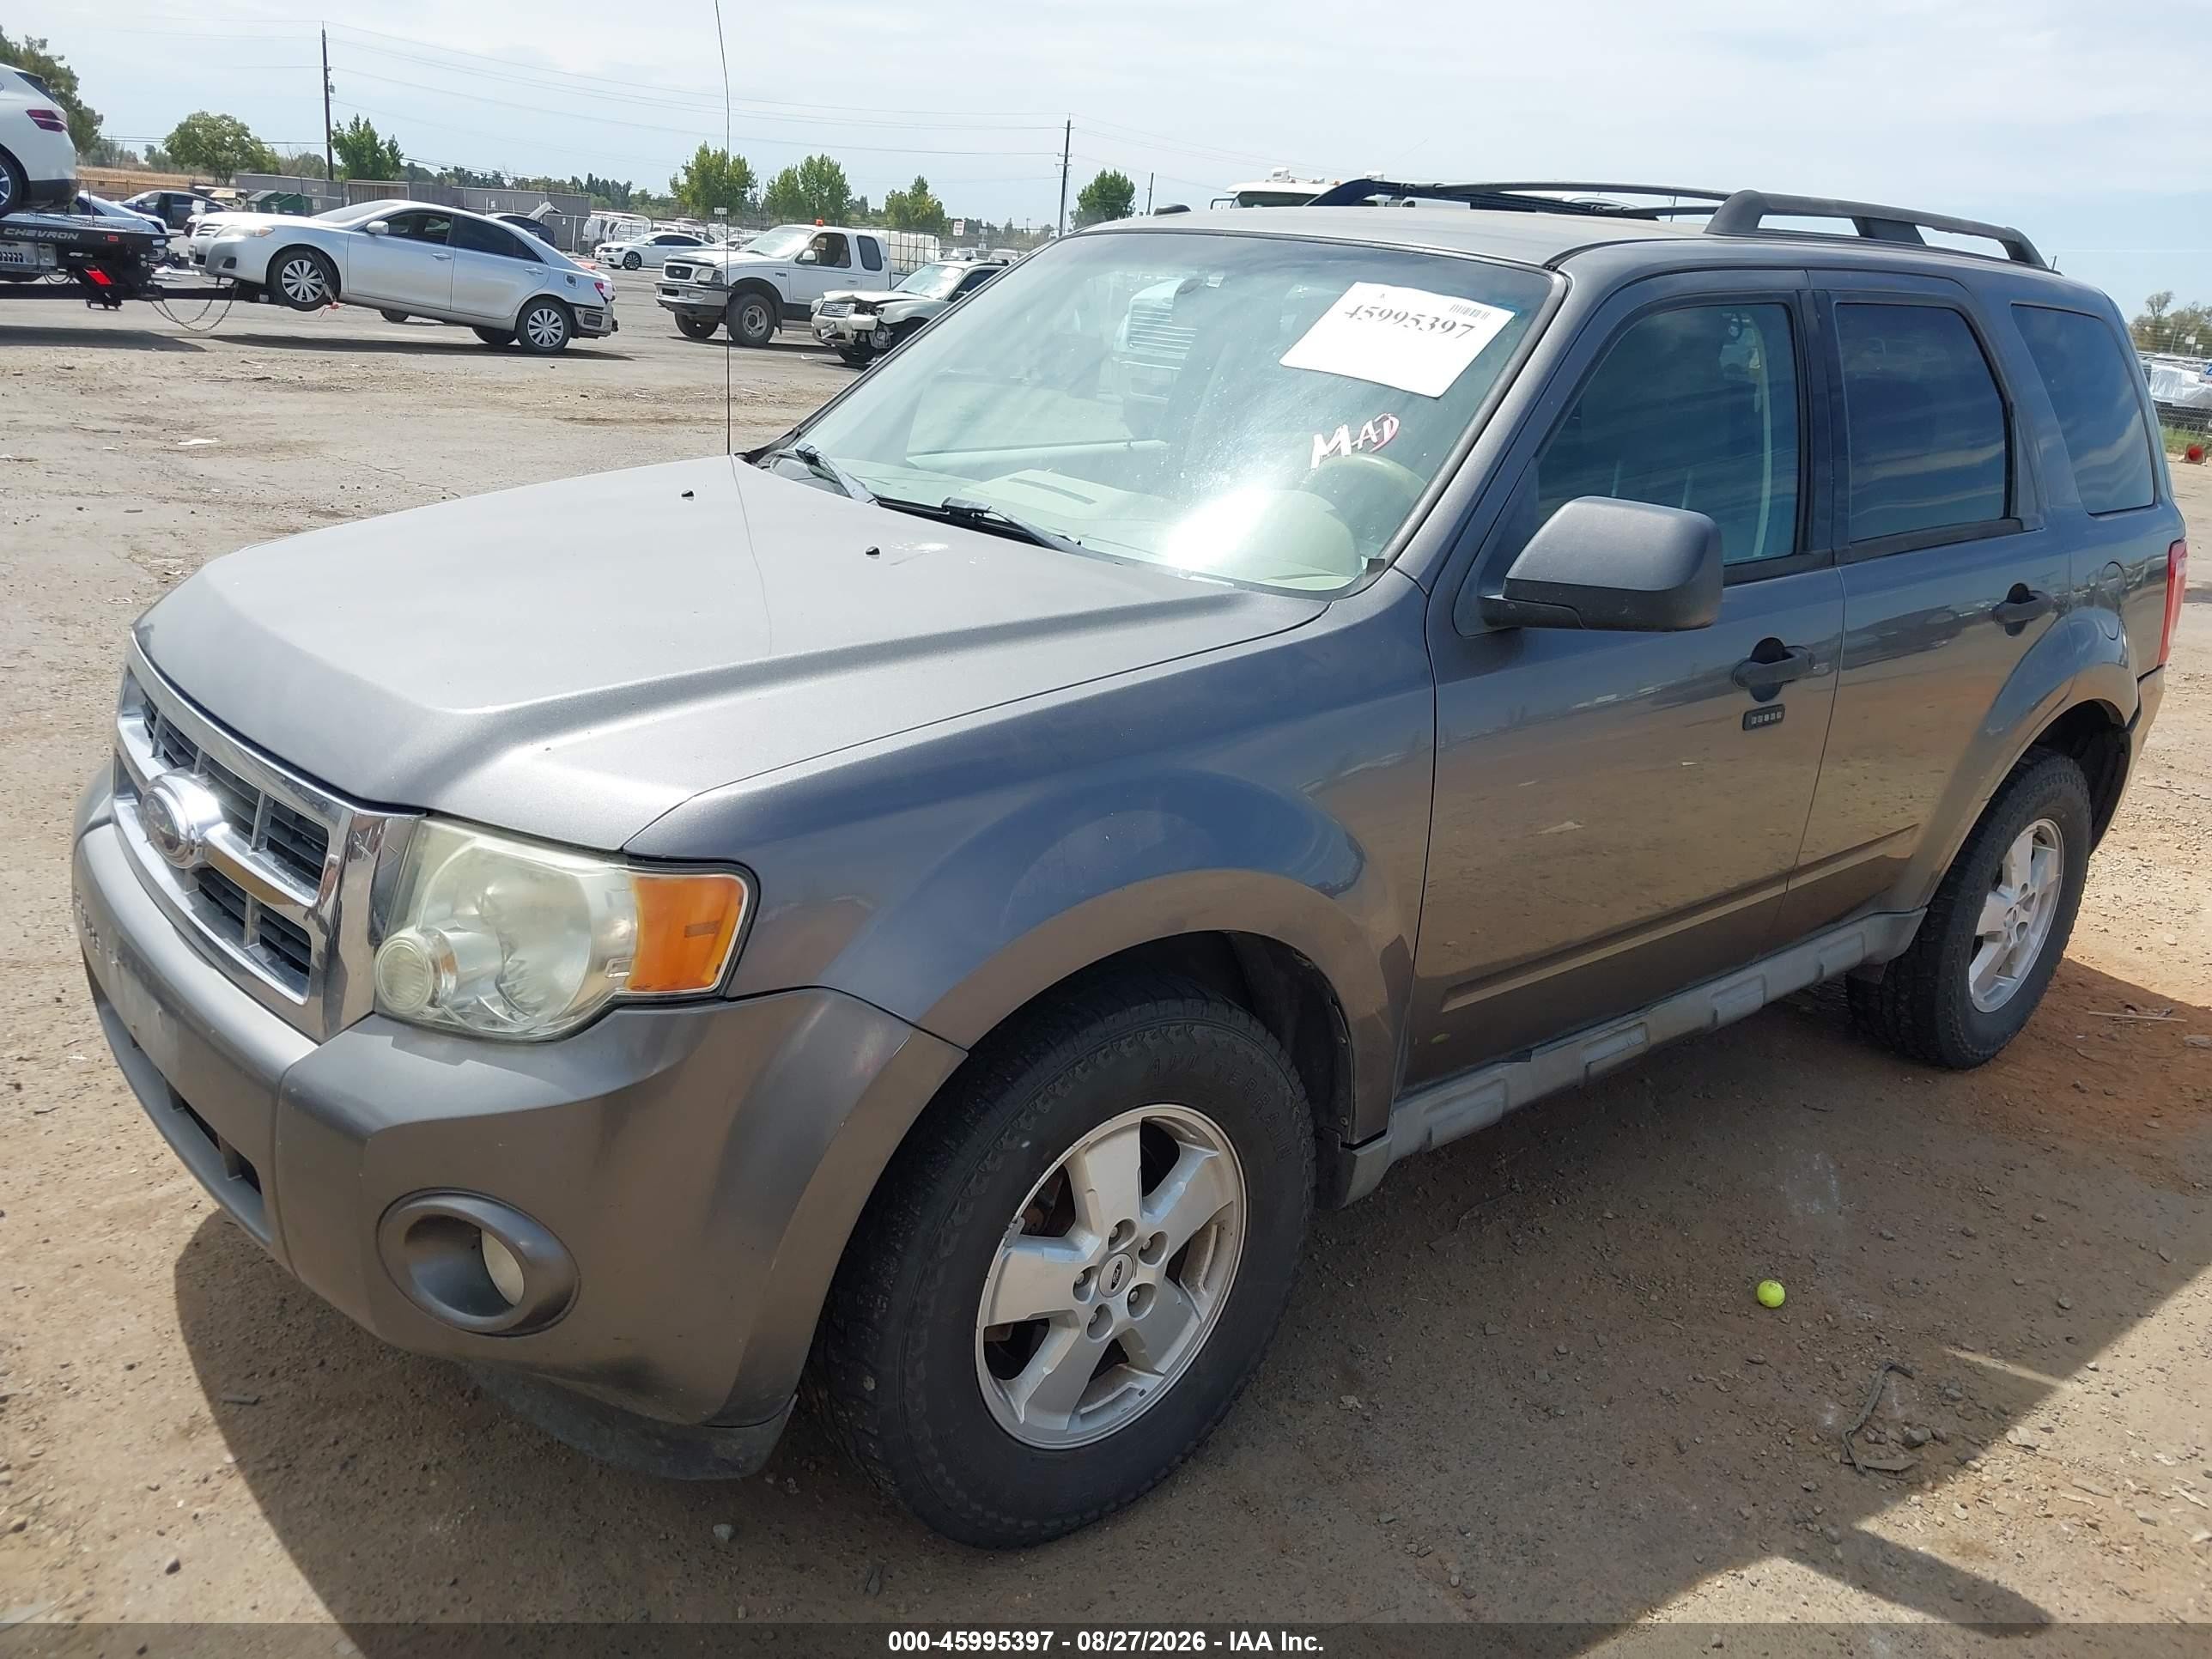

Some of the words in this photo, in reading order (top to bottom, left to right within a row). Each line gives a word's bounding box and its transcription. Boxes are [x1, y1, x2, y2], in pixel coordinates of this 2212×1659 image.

[3, 228, 80, 240] CHEVRON
[1344, 304, 1476, 339] 45995397
[1310, 412, 1401, 470] MAD
